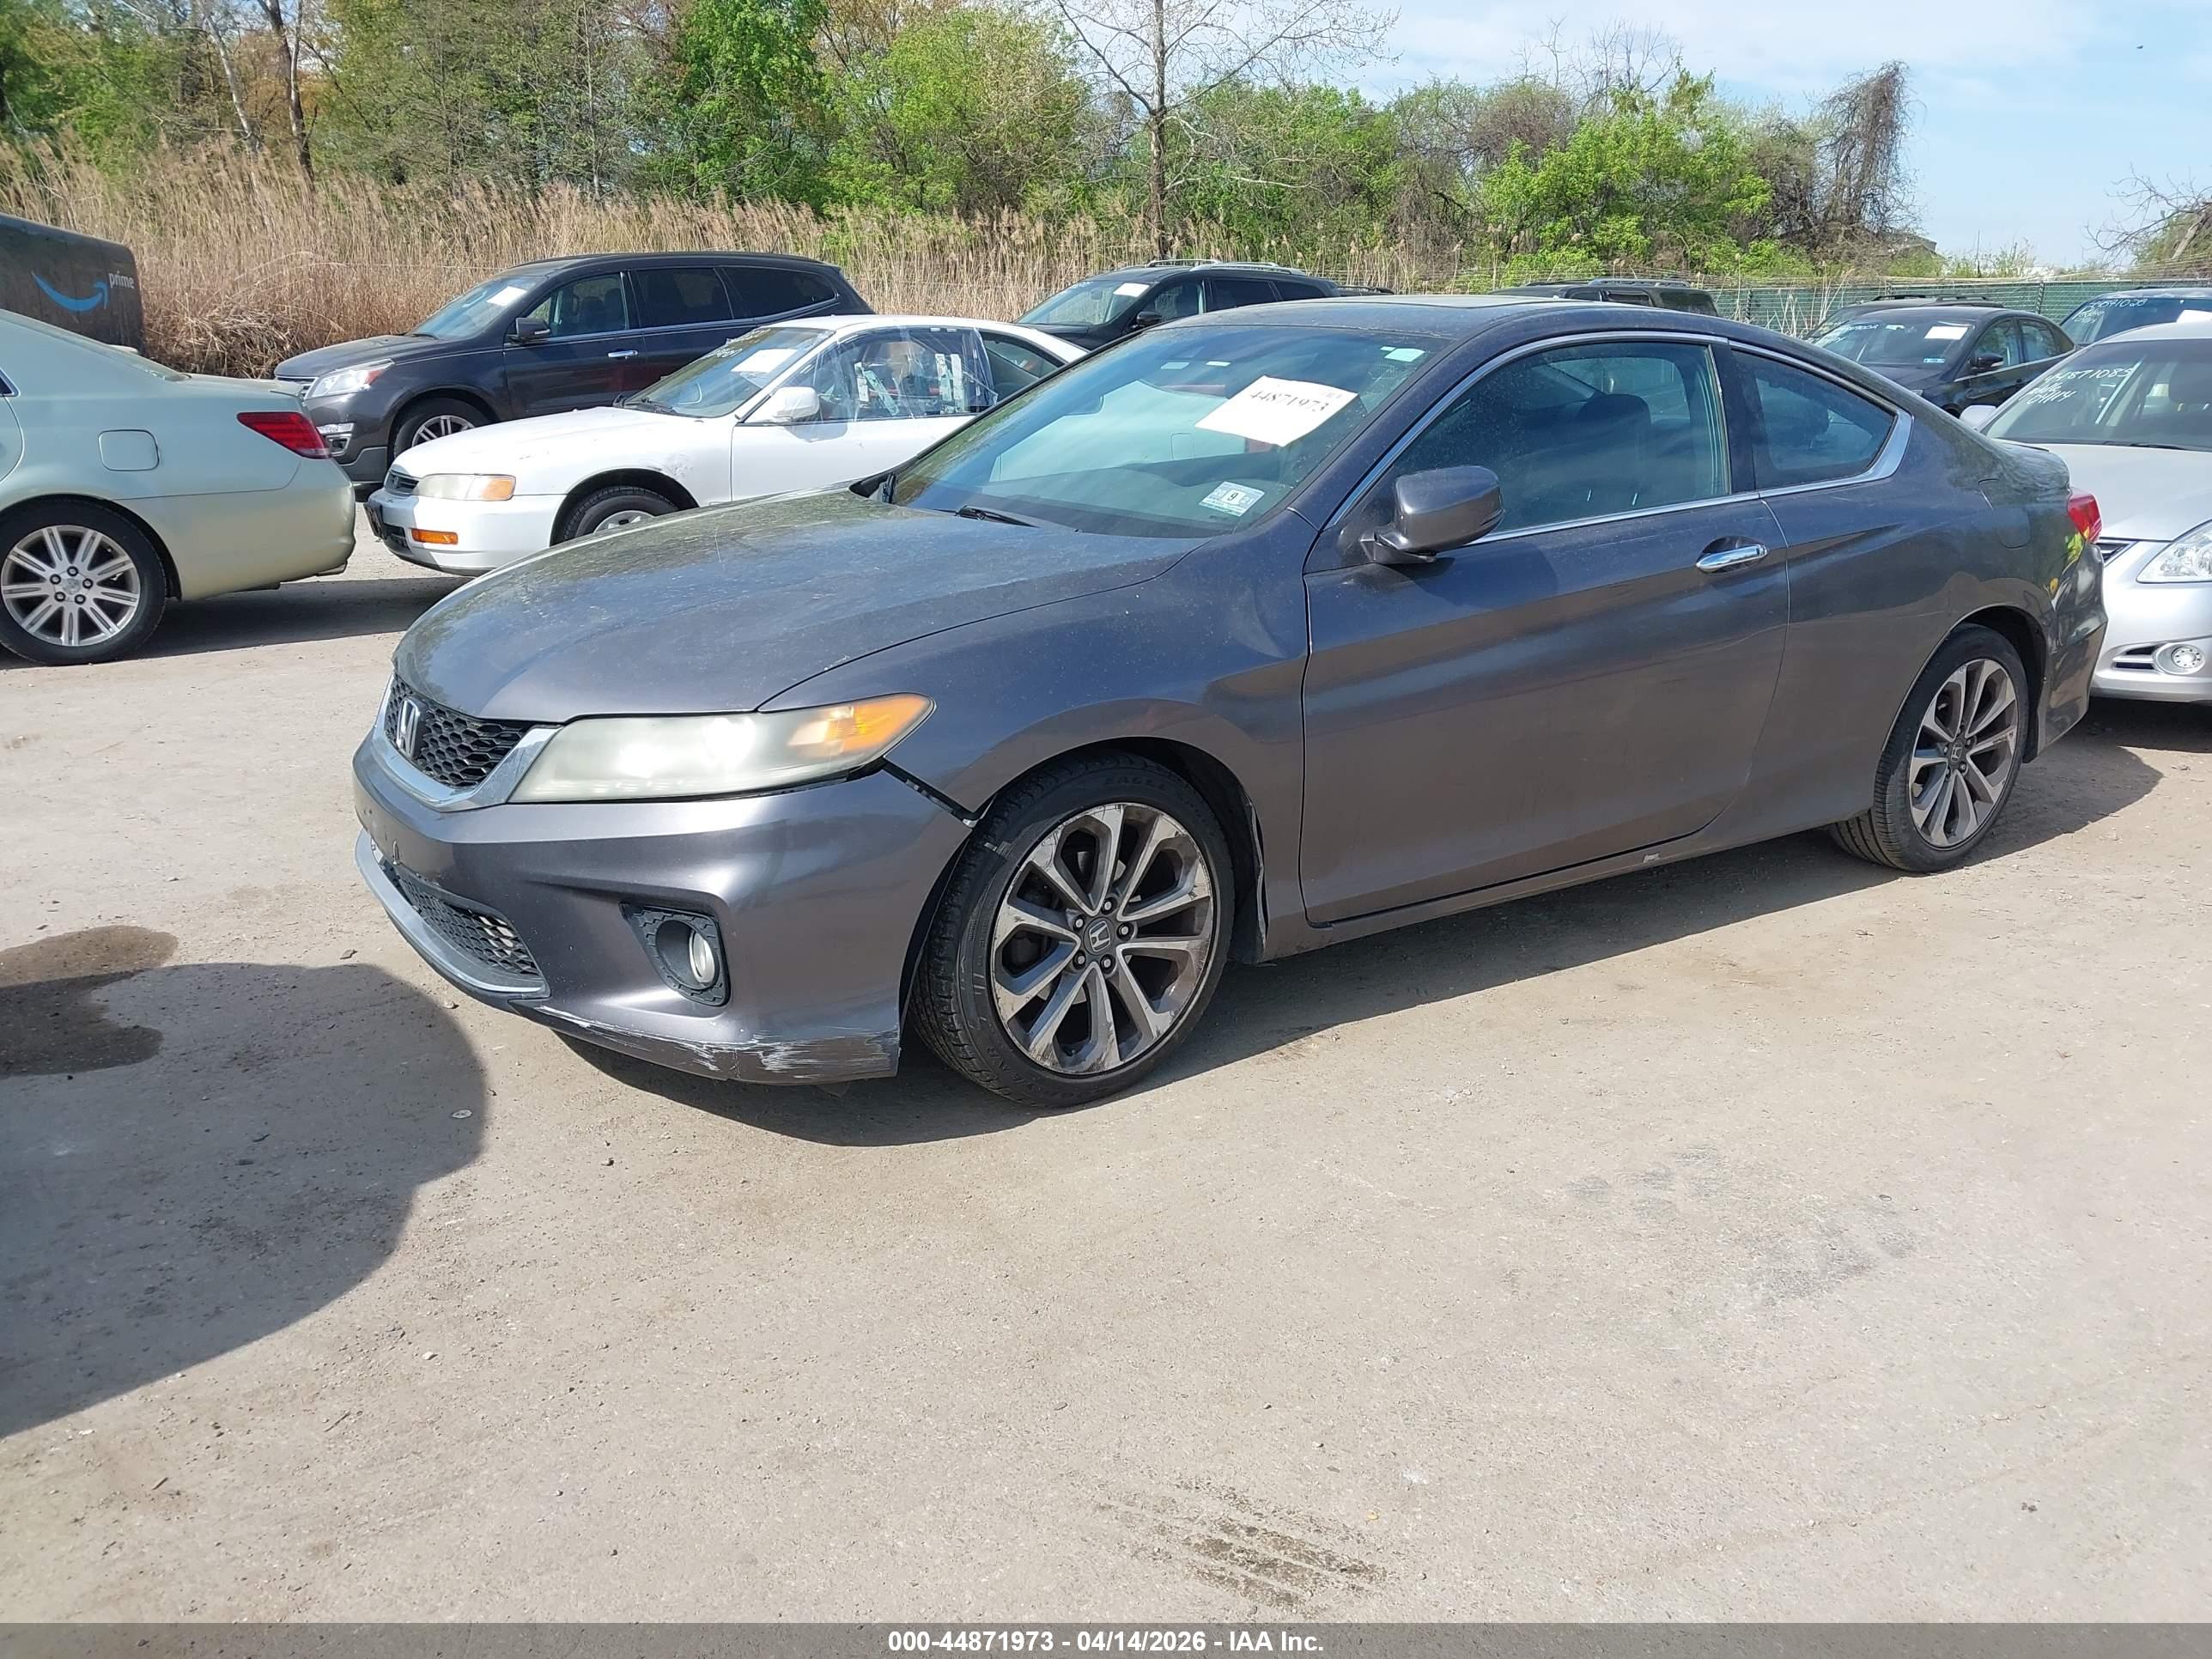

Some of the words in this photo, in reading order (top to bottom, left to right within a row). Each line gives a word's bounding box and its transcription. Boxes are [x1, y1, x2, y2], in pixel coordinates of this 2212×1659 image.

[108, 270, 135, 289] prime
[1250, 390, 1330, 412] 44871973
[1227, 492, 1239, 501] 9
